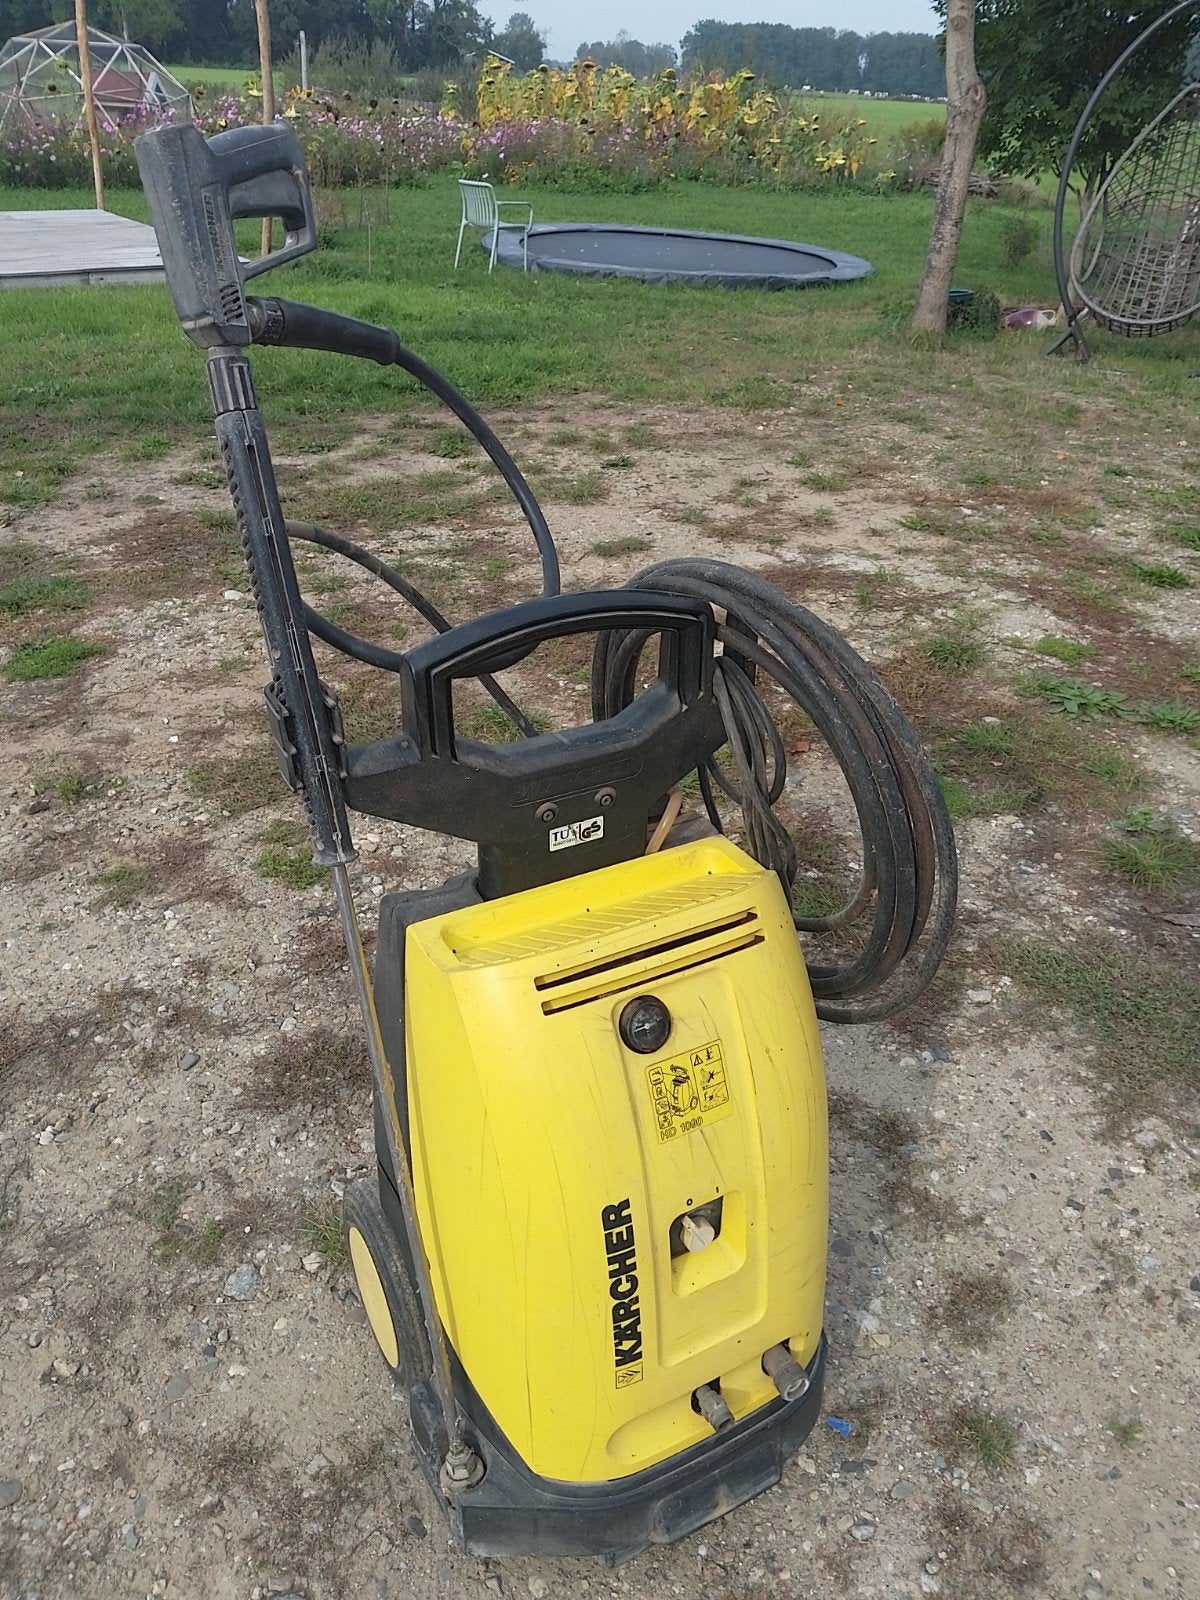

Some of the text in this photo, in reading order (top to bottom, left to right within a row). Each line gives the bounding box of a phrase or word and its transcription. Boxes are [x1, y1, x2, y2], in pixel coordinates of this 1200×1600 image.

[582, 821, 602, 839] GS
[660, 1126, 677, 1141] HD
[601, 1198, 642, 1367] KÄRCHER
